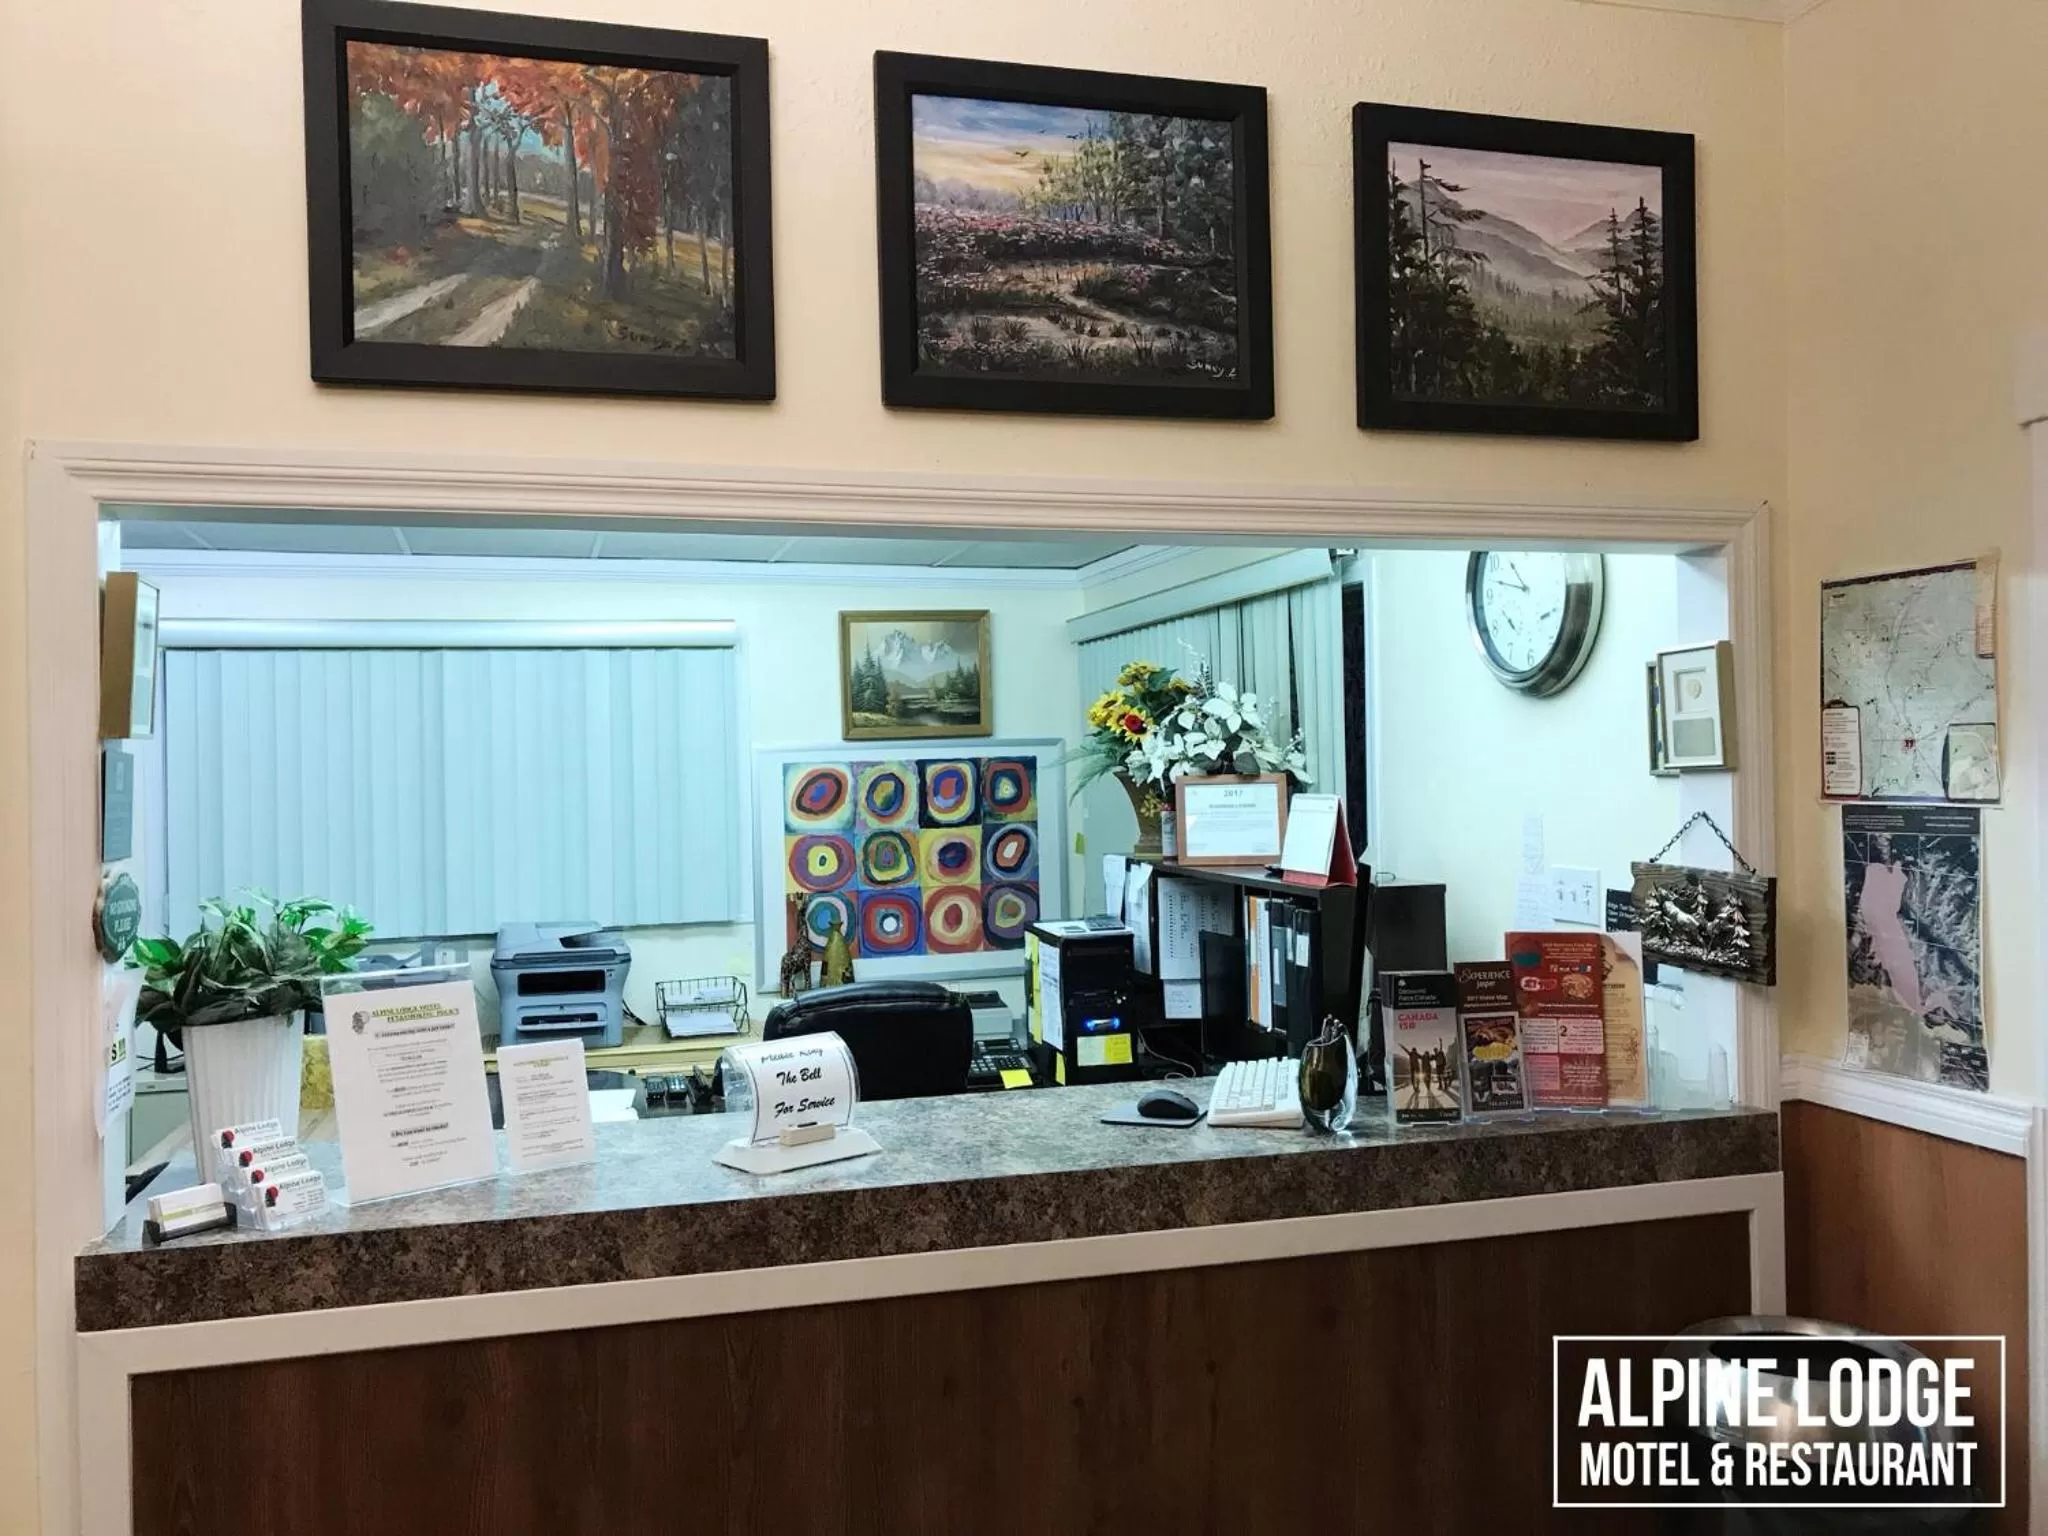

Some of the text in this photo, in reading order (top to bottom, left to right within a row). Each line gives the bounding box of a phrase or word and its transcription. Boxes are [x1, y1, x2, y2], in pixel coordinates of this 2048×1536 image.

[1398, 1012, 1439, 1021] CANADA
[1560, 1025, 1568, 1037] 2
[776, 1067, 822, 1086] The Bell
[774, 1096, 836, 1118] For Service
